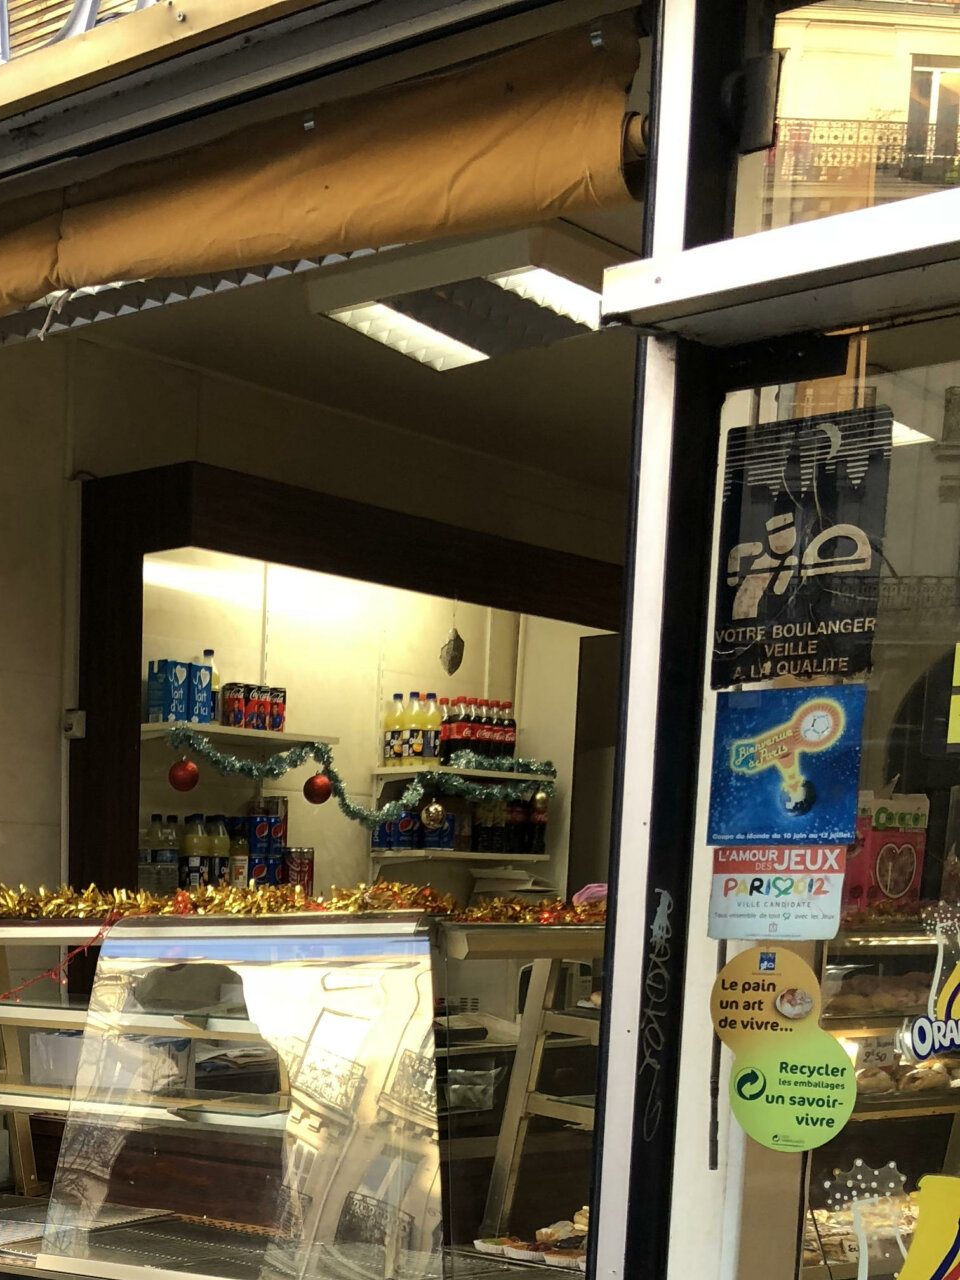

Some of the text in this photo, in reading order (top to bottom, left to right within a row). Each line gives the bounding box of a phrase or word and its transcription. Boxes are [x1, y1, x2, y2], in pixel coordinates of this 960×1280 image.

[715, 617, 876, 644] VOTRE BOULANGER
[765, 640, 818, 658] VEILLE
[750, 662, 770, 680] LA
[776, 657, 849, 676] QUALITE
[735, 729, 793, 765] Bienvenue
[753, 744, 788, 767] Paris
[793, 832, 807, 840] juin
[718, 849, 778, 862] L'AMOUR
[755, 848, 840, 870] DES JEUX
[764, 901, 811, 909] CANDIDATE
[721, 978, 776, 994] Le pain
[720, 999, 764, 1011] un art
[718, 1016, 793, 1032] de vivre...
[778, 1061, 847, 1078] Recycler
[778, 1078, 846, 1091] les emballages
[765, 1094, 844, 1109] un savoir-
[795, 1113, 835, 1128] vivre
